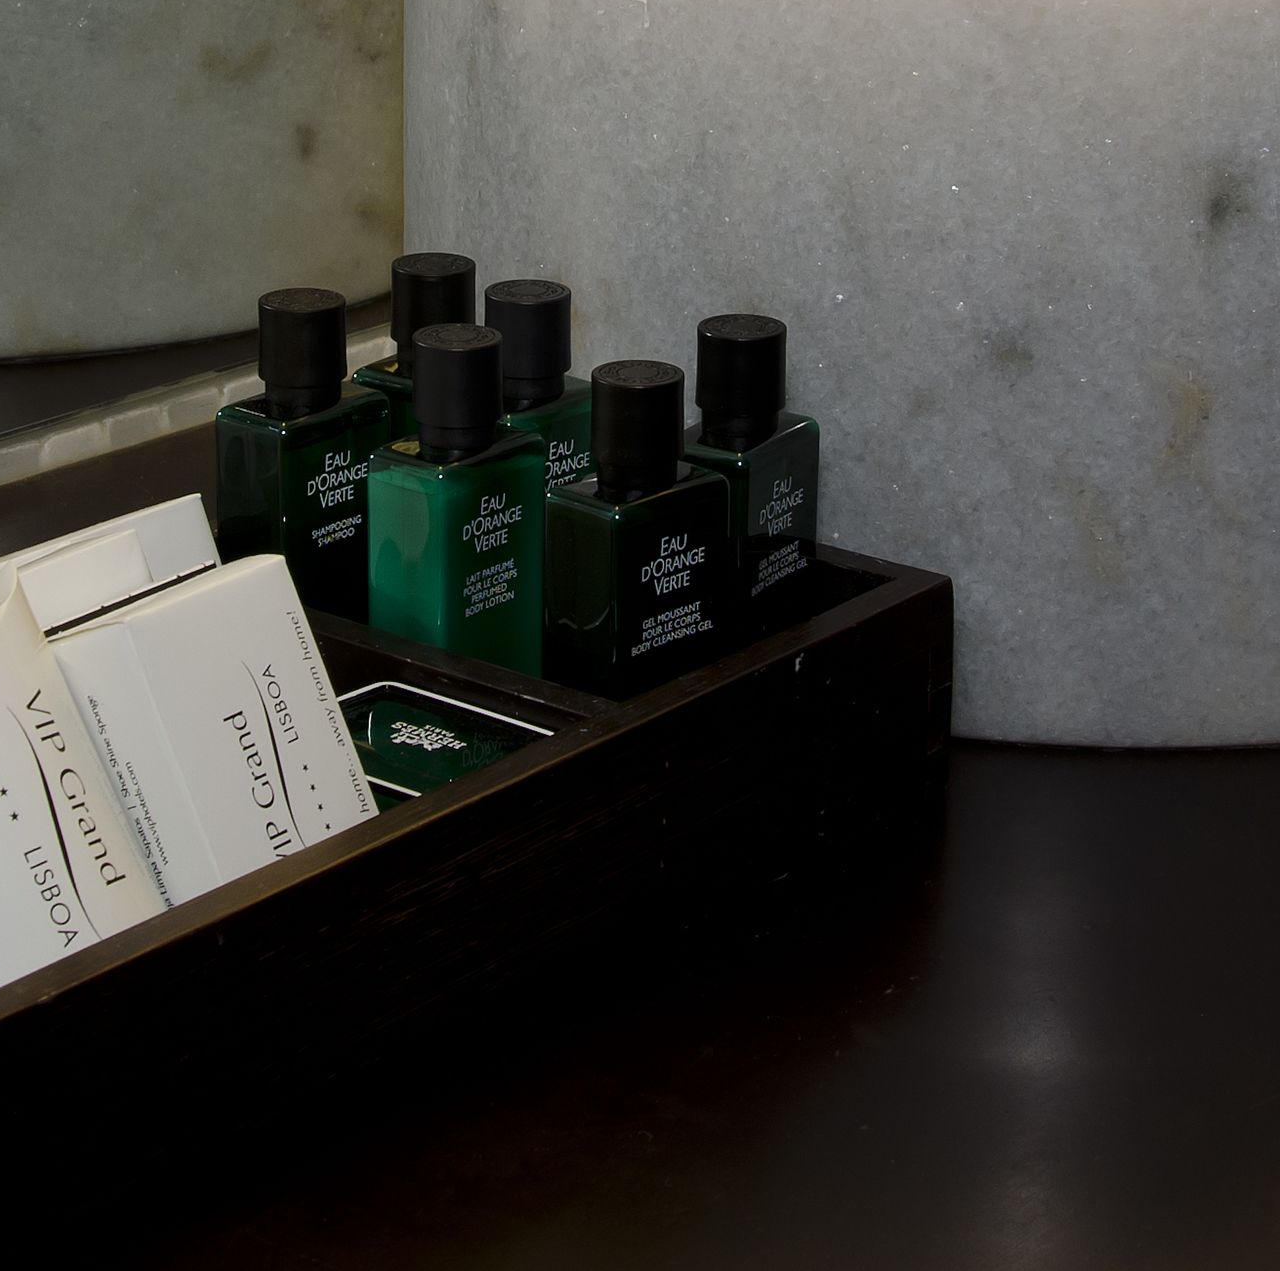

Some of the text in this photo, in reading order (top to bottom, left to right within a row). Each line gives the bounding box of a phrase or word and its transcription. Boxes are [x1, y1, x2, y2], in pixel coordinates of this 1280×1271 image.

[325, 450, 351, 472] EAU
[549, 439, 575, 460] EAU
[307, 462, 368, 496] D'ORANGE
[320, 484, 354, 508] VERTE
[773, 476, 792, 499] EAU
[480, 492, 506, 515] EAU
[760, 488, 804, 525] D'ORANGE
[463, 505, 523, 541] D'ORANGE
[475, 528, 509, 553] VERTE
[767, 511, 793, 537] VERTE
[660, 533, 688, 557] EAU
[641, 546, 705, 582] D'ORANGE
[654, 570, 691, 596] VERTE
[286, 610, 312, 661] home!
[310, 666, 328, 702] from
[87, 695, 106, 735] Sponge
[262, 664, 299, 745] LISBOA
[325, 707, 345, 747] away
[104, 737, 120, 769] Shine
[223, 710, 275, 809] Grand
[26, 689, 127, 886] VIP Grand
[117, 771, 131, 798] Shoe
[125, 761, 169, 866] www.viphotels.com
[23, 846, 79, 948] LISBOA
